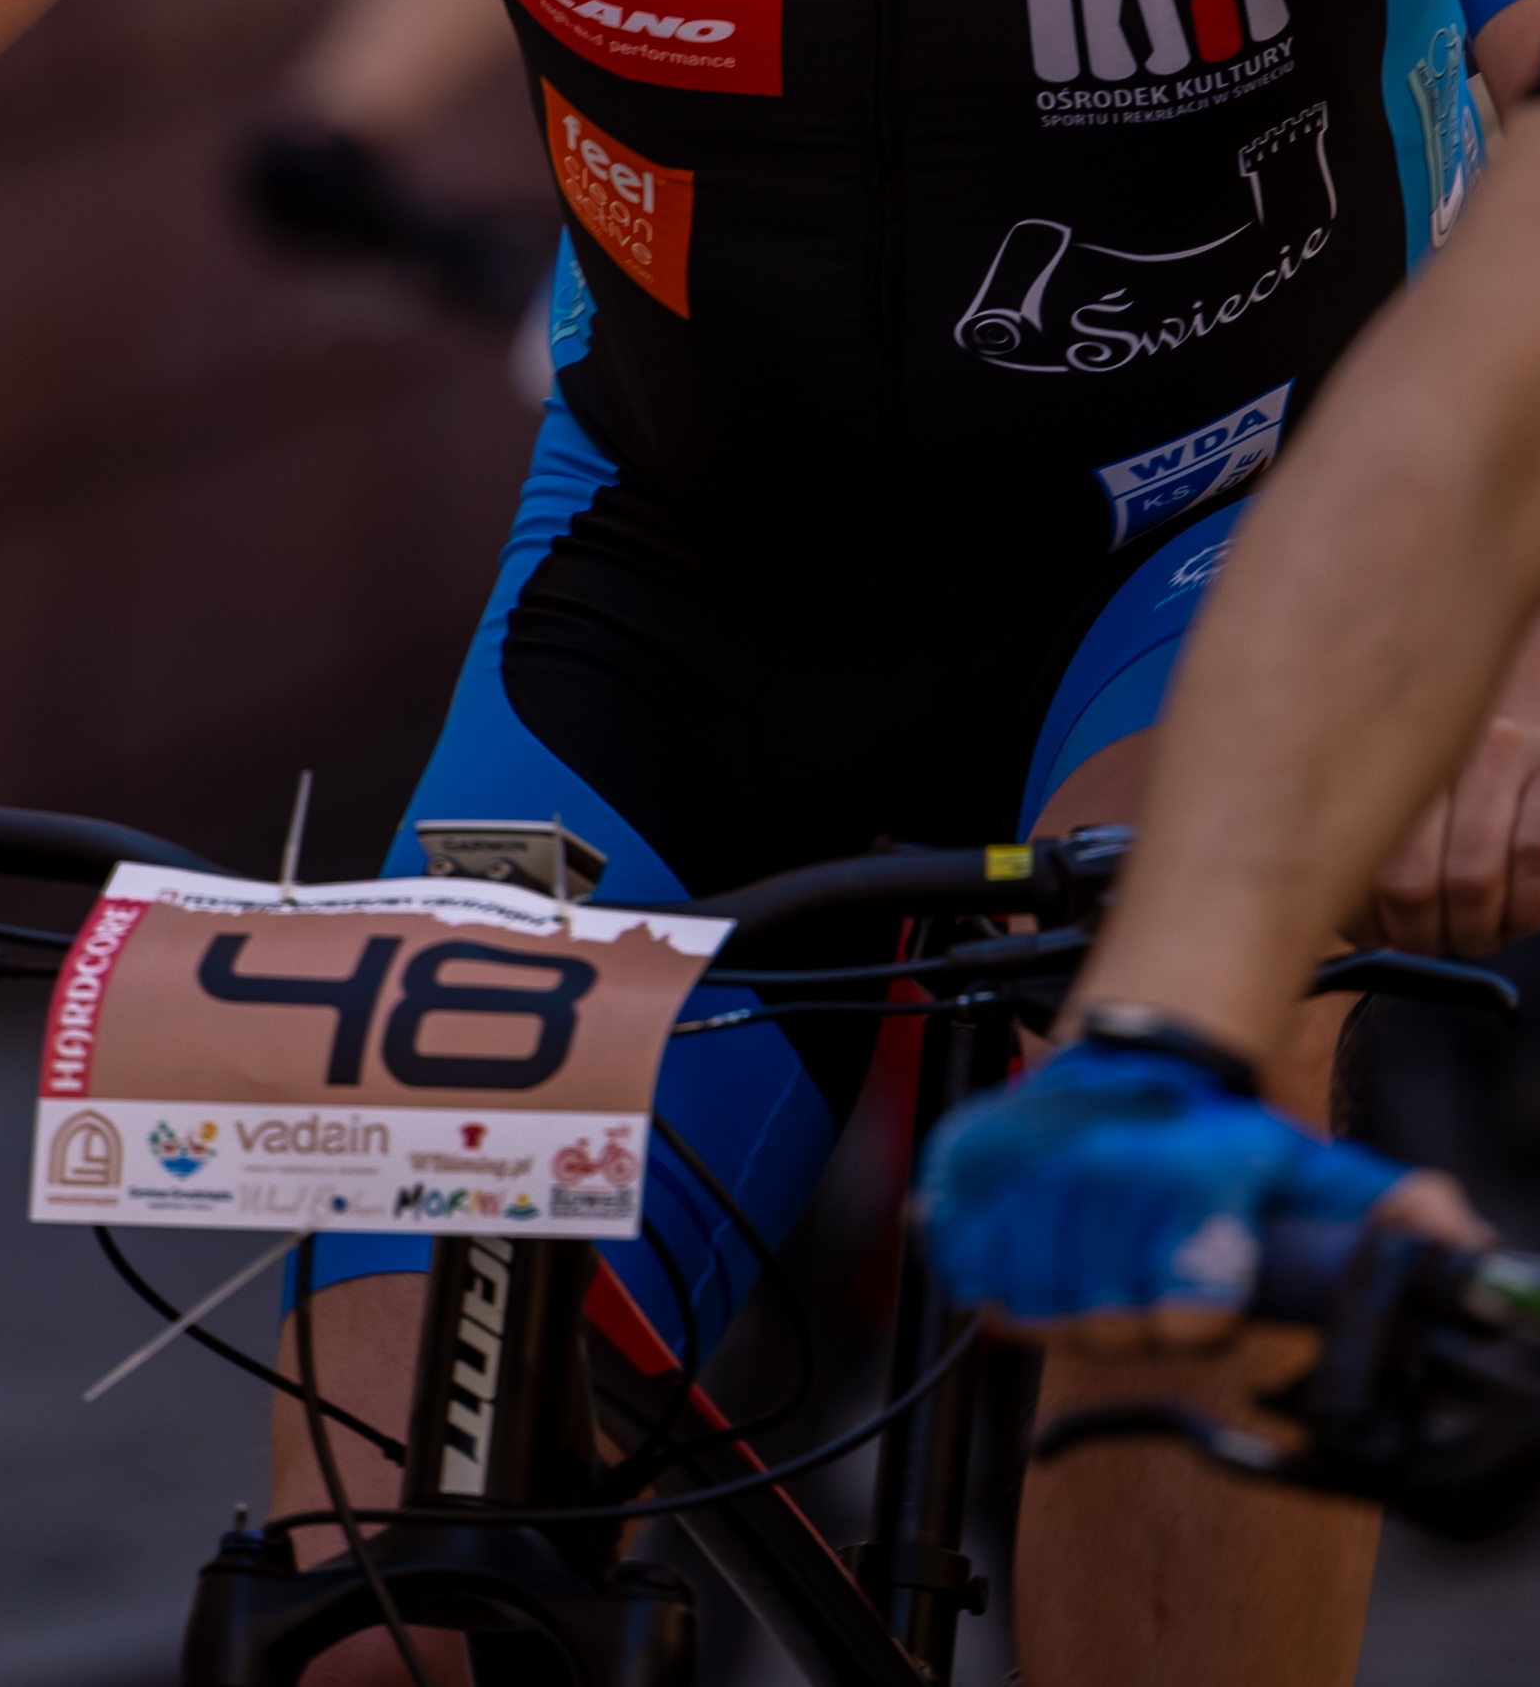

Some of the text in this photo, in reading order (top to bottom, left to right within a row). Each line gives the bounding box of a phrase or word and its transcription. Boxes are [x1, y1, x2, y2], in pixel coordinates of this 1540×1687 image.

[609, 40, 736, 69] performance
[1036, 36, 1294, 112] OŚRODEK KULTURY
[1040, 110, 1108, 128] SPORTU
[1123, 98, 1209, 125] REKREACJI
[1232, 59, 1295, 100] ŚWIECIU
[562, 114, 655, 214] feel
[1065, 227, 1332, 373] Świecie
[1129, 408, 1270, 481] WDA
[48, 902, 142, 1092] HARDCORE
[196, 933, 599, 1090] 48
[234, 1113, 391, 1155] vadain
